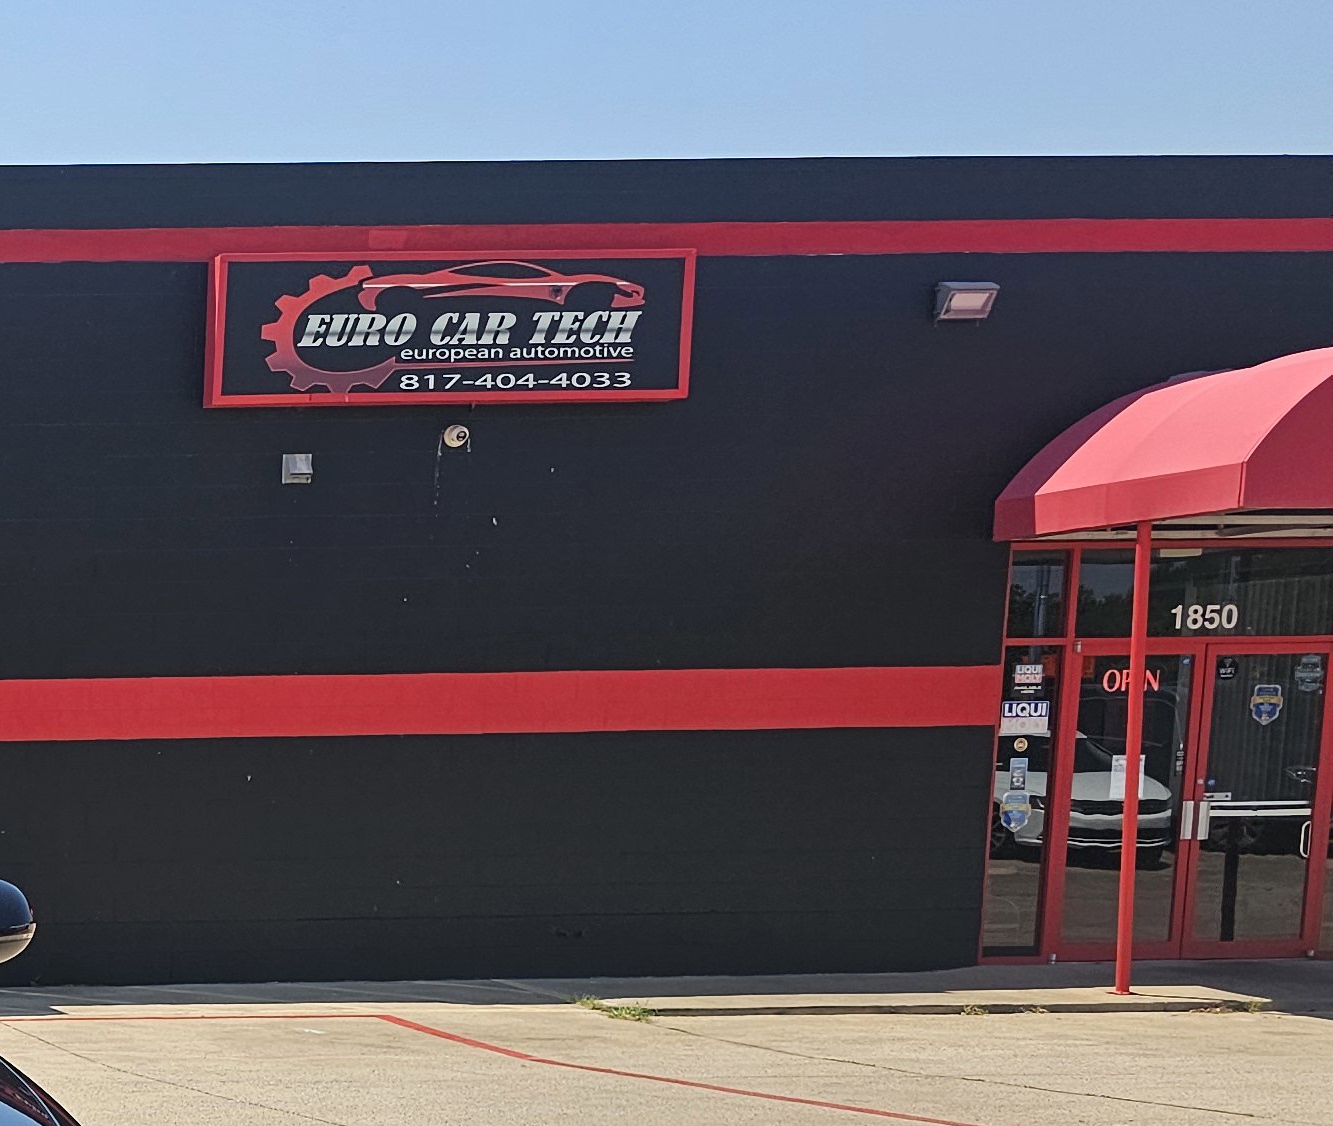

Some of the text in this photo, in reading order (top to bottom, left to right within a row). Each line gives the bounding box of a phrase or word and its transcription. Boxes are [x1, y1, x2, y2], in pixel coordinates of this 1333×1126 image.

[297, 311, 643, 347] EURO CAR TECH
[400, 344, 634, 362] european automotive
[399, 372, 631, 391] 817-404-4033
[1171, 604, 1238, 629] 1850
[1102, 669, 1161, 692] OPN
[1004, 703, 1047, 717] LIQUI
